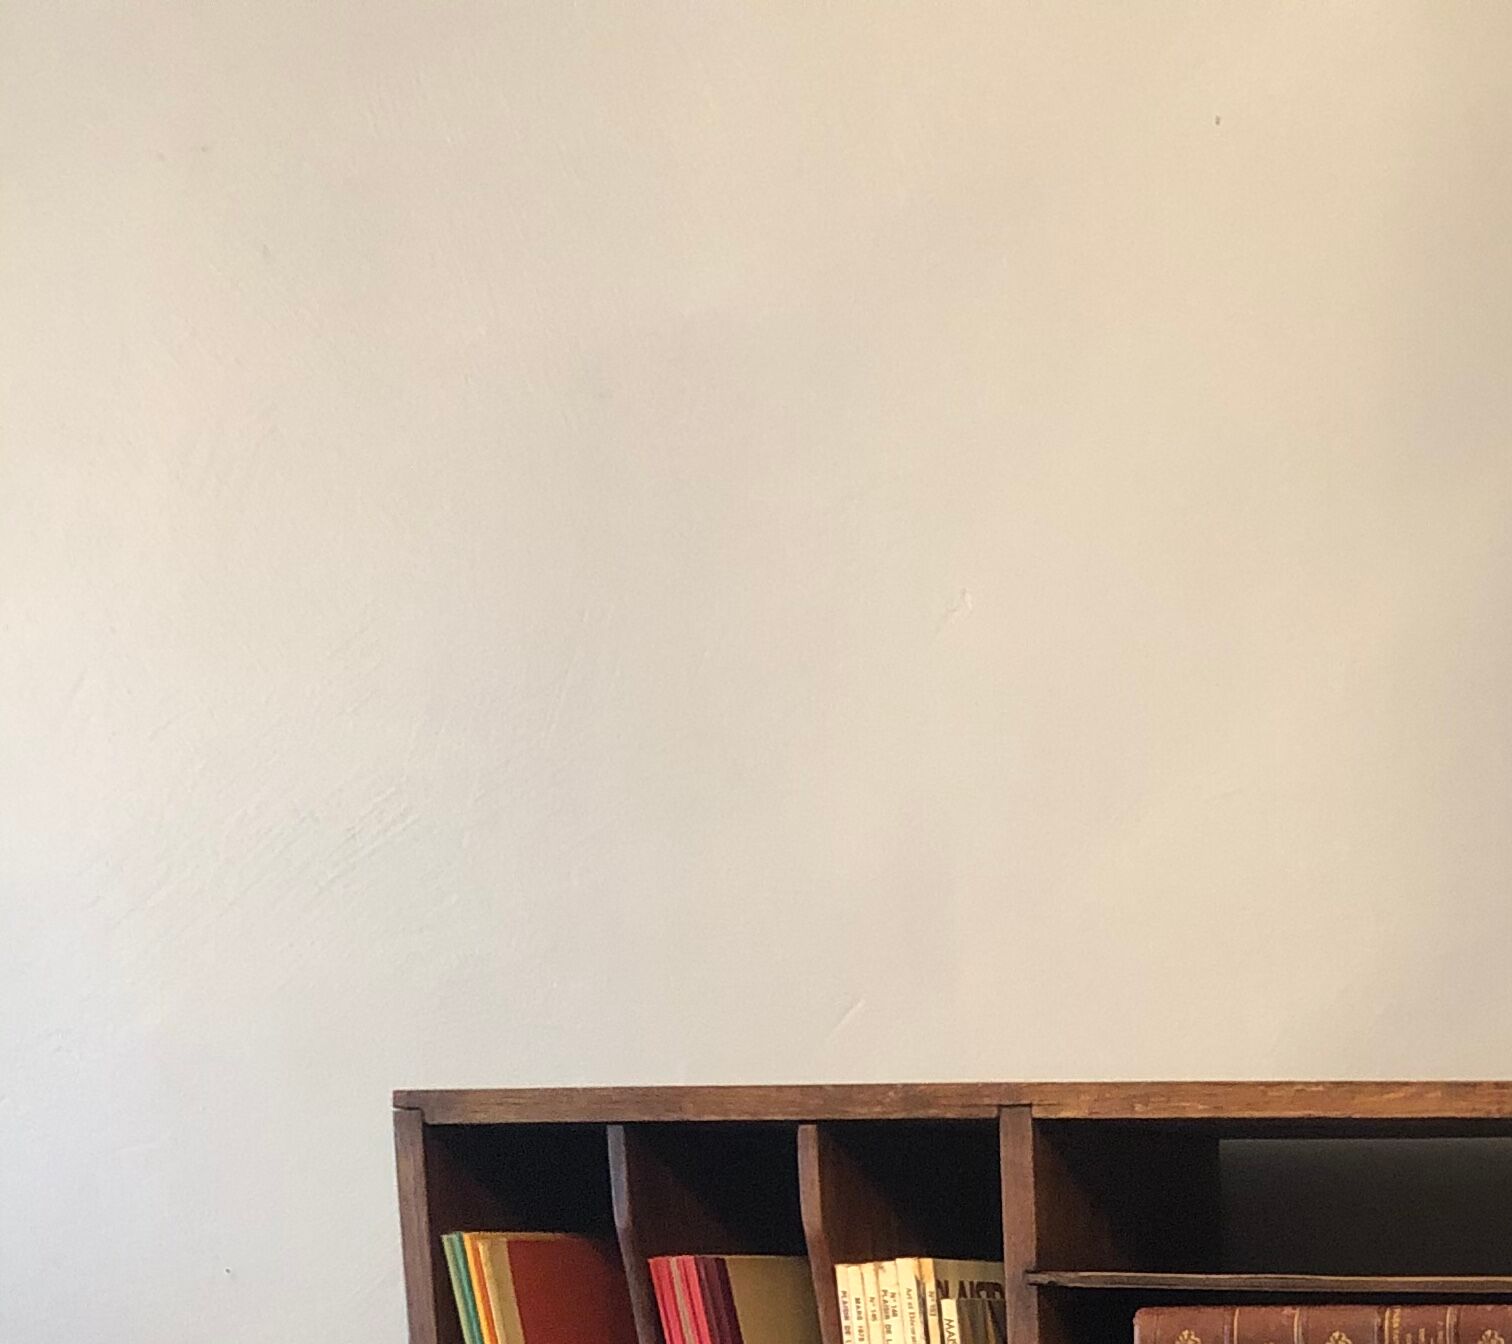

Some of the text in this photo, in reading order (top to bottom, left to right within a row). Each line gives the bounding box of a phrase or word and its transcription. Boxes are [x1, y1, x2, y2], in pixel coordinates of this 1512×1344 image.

[905, 1287, 913, 1299] Art
[840, 1290, 850, 1320] PLAISIR
[854, 1297, 862, 1320] MARS
[881, 1288, 890, 1319] PLAISIR
[844, 1324, 851, 1335] DE
[885, 1323, 892, 1334] DE
